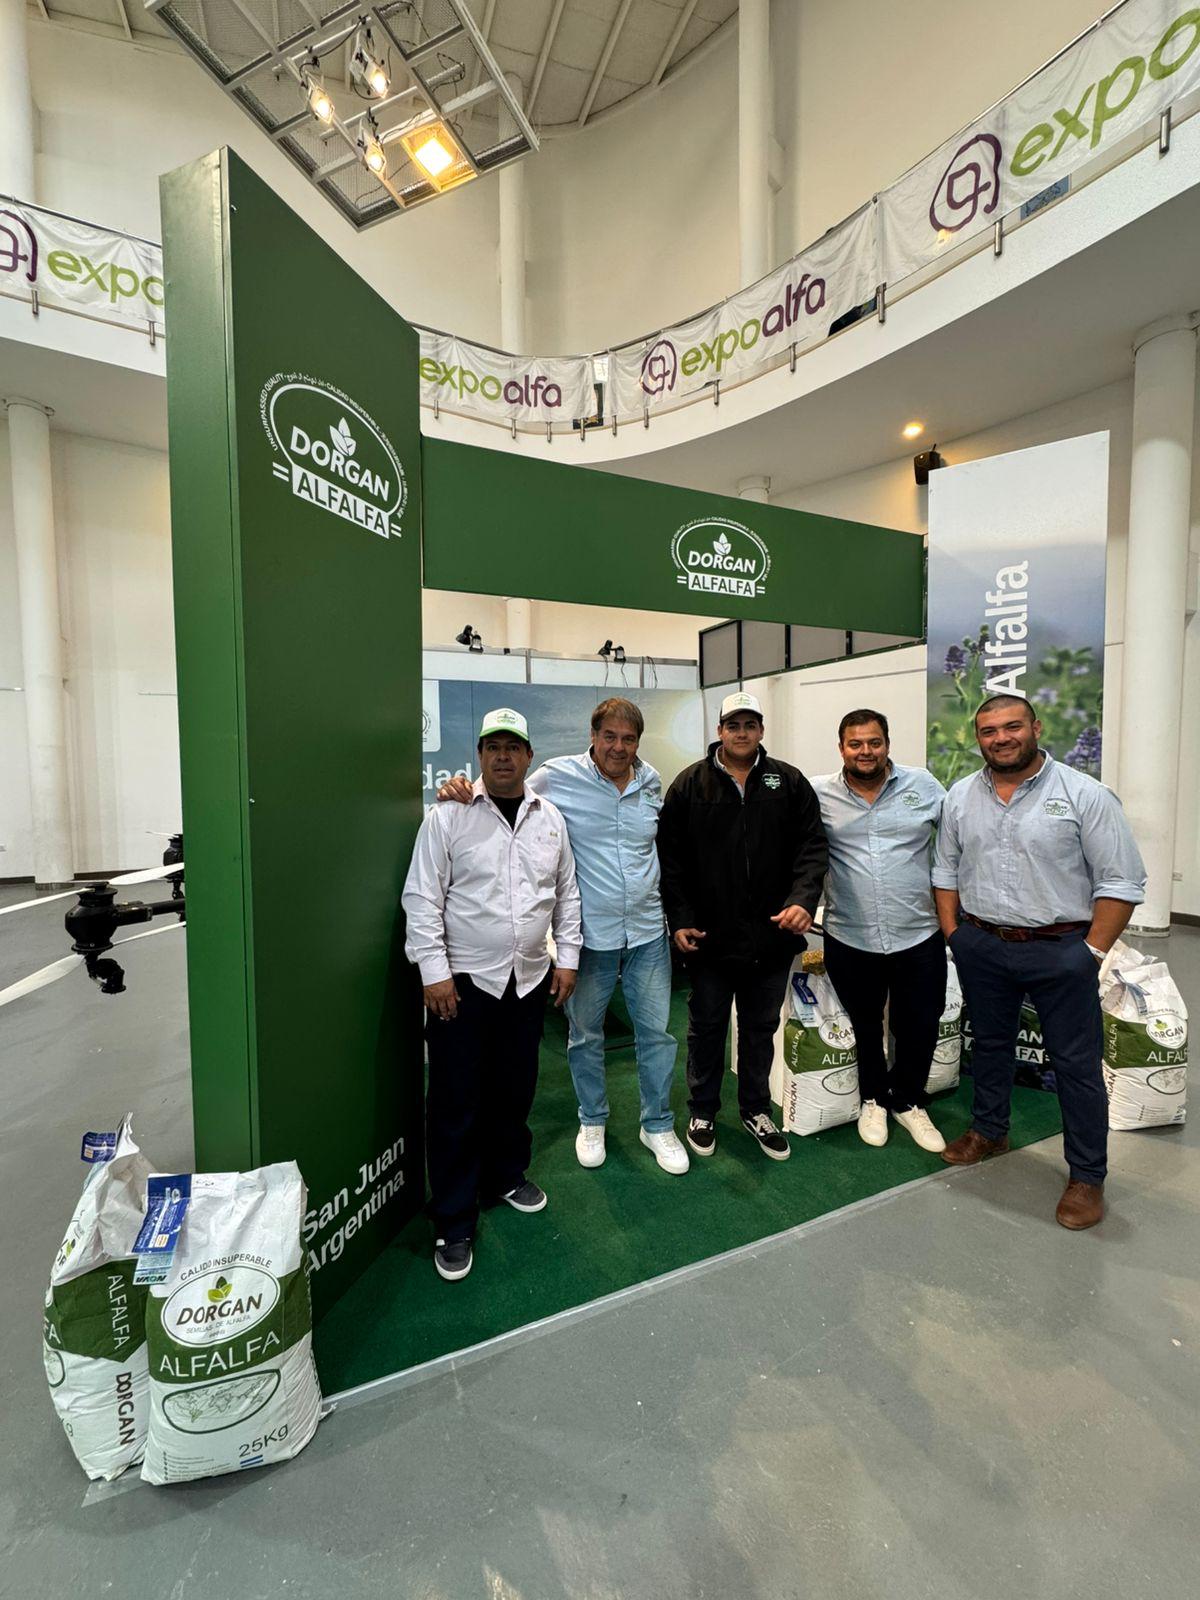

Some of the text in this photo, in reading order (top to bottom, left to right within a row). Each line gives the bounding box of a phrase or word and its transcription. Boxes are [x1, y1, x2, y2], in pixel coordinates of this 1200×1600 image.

[1009, 8, 1200, 177] expo
[290, 425, 390, 502] DORGAN
[297, 471, 386, 535] ALFALFA
[688, 550, 756, 574] DORGAN
[691, 574, 753, 596] ALFALFA
[984, 559, 1030, 698] Alfalfa
[1108, 1023, 1118, 1062] ALFALFA
[302, 1137, 405, 1243] San Juan
[306, 1170, 405, 1277] Argentina
[213, 1253, 272, 1269] INSUPERABLE
[107, 1274, 130, 1350] ALFALFA
[176, 1293, 263, 1326] DORGAN
[159, 1331, 280, 1377] ALFALFA
[115, 1372, 136, 1446] DORGAN
[238, 1424, 289, 1458] 25Kg
